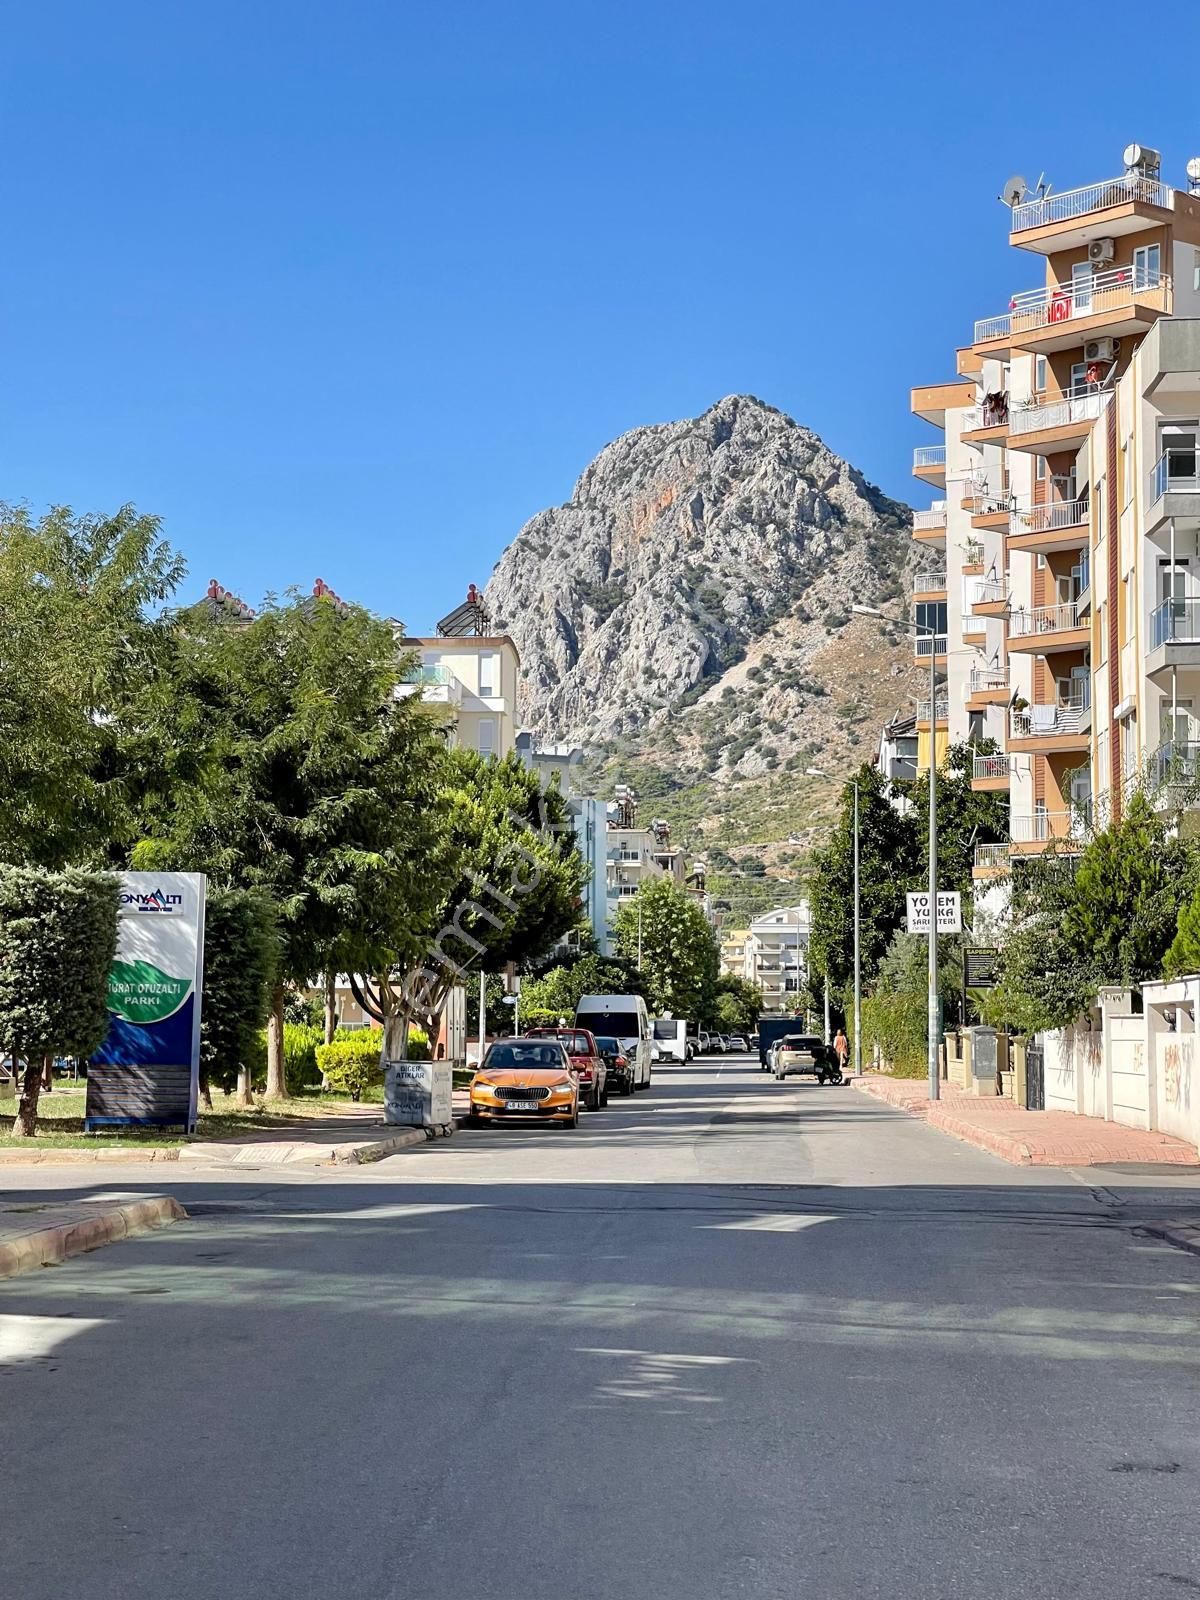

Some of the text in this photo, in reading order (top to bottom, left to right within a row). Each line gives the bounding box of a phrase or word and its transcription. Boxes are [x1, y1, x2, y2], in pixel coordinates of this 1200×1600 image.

[120, 888, 182, 907] ONYAALTI
[911, 895, 955, 907] YÖEM
[915, 908, 954, 917] YUKA
[138, 983, 181, 994] OTUZALTI
[124, 996, 160, 1005] PARKI
